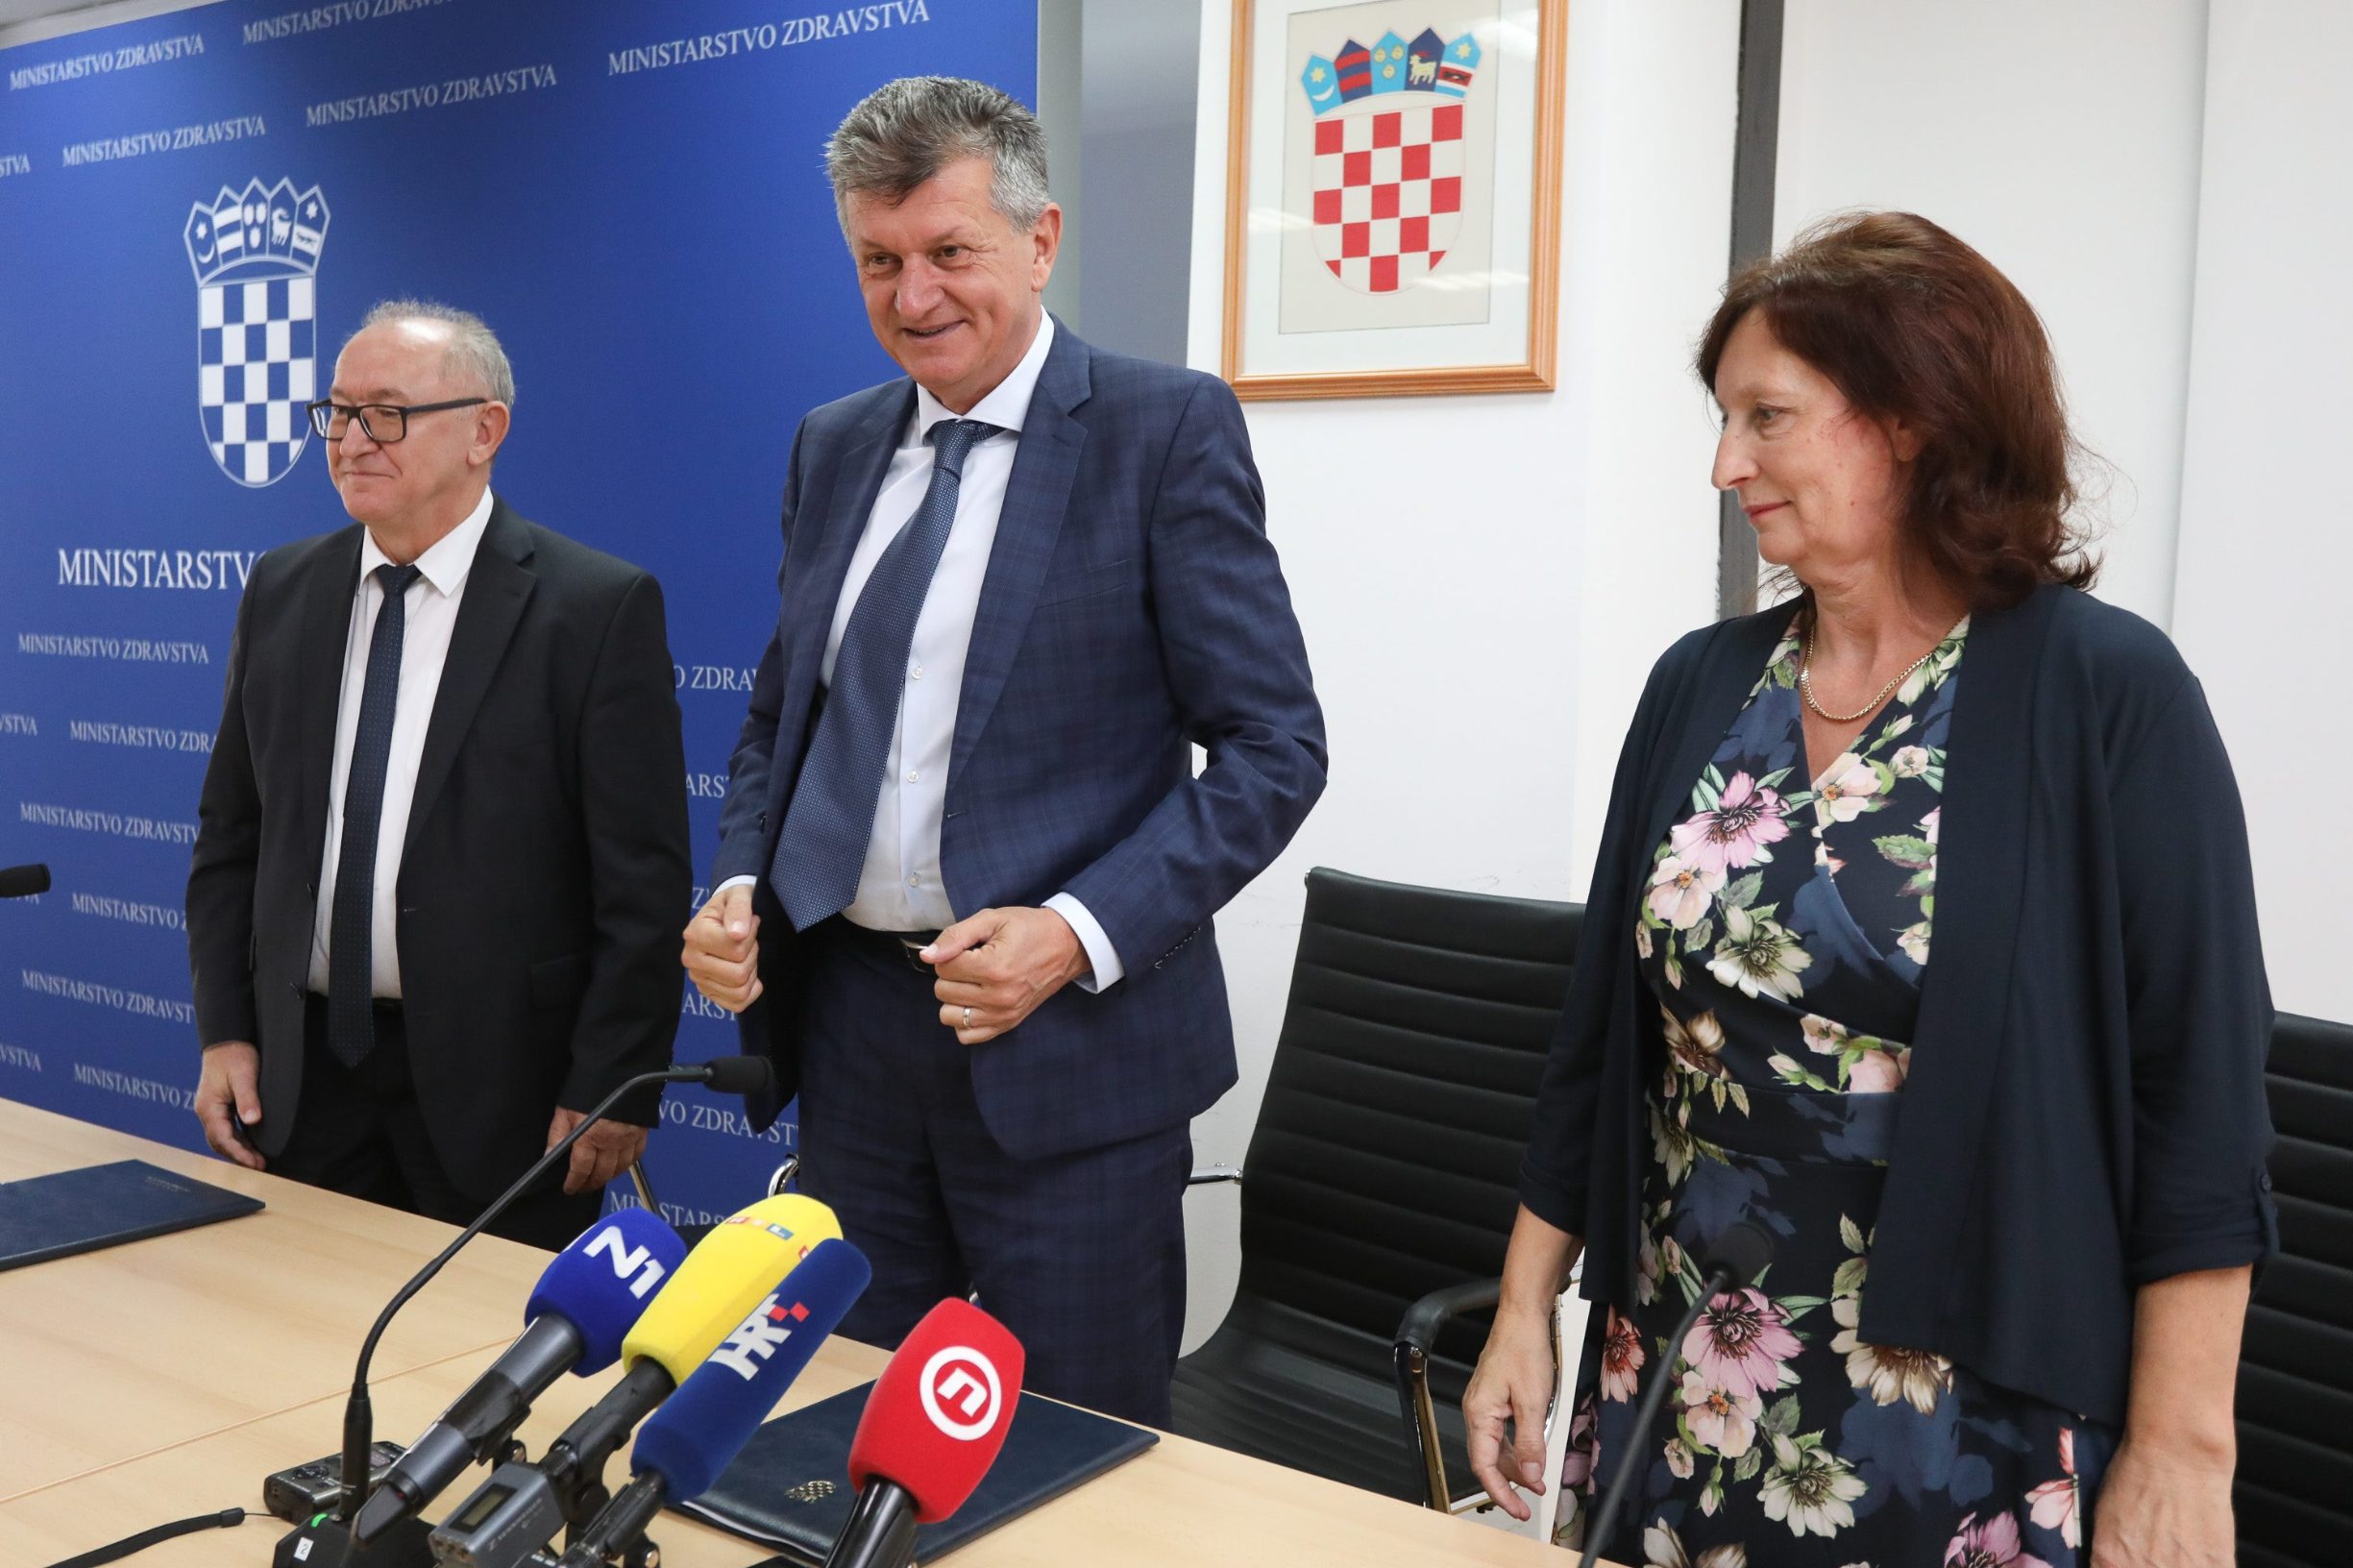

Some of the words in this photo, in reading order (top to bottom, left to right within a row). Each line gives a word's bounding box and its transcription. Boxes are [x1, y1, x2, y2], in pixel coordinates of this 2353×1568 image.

[242, 0, 369, 45] MINISTARSTVO
[607, 24, 776, 76] MINISTARSTVO
[781, 0, 930, 47] ZDRAVSTVA
[10, 51, 114, 91] MINISTARSTVO
[114, 33, 205, 70] ZDRAVSTVA
[306, 85, 438, 127] MINISTARSTVO
[442, 63, 557, 105] ZDRAVSTVA
[62, 130, 170, 167] MINISTARSTVO
[173, 114, 266, 150] ZDRAVSTVA
[58, 548, 266, 590] MINISTARSTV
[18, 632, 119, 659] MINISTARSTVO
[122, 640, 209, 664] ZDRAVSTVA
[70, 721, 176, 750] MINISTARSTVO
[20, 801, 121, 835] MINISTARSTVO
[72, 892, 179, 930] MINISTARSTVO
[22, 968, 124, 1009] MINISTARSTVO
[127, 992, 196, 1024] ZDRAVST
[74, 1062, 181, 1107] MINISTARSTVO
[582, 1225, 666, 1300] N1
